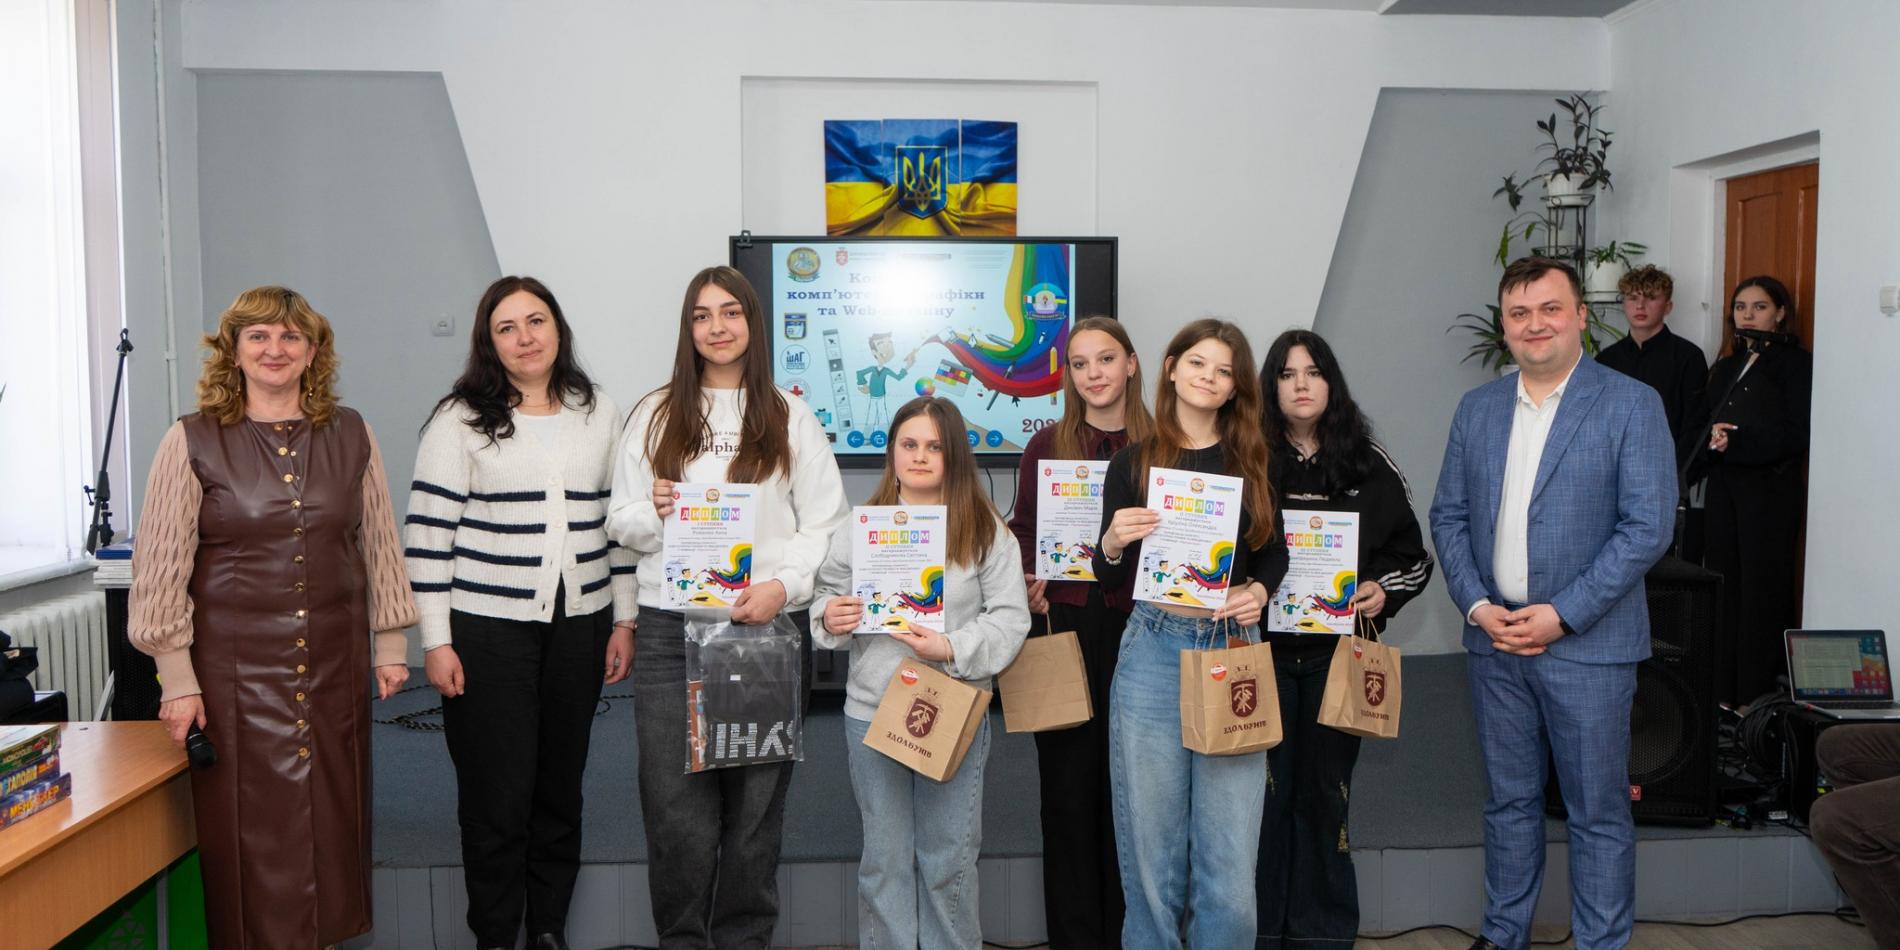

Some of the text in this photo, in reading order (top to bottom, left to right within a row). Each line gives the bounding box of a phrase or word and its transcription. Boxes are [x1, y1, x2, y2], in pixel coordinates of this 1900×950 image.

[817, 306, 837, 316] та
[1052, 483, 1104, 496] ДИПЛО
[1164, 495, 1224, 516] ДИПЛОМ
[681, 507, 740, 520] ДИПЛОМ
[869, 531, 929, 544] ДИПЛОМ
[1286, 533, 1342, 548] ДИПЛОМ
[886, 730, 932, 759] ЗДОЛБУНІВ
